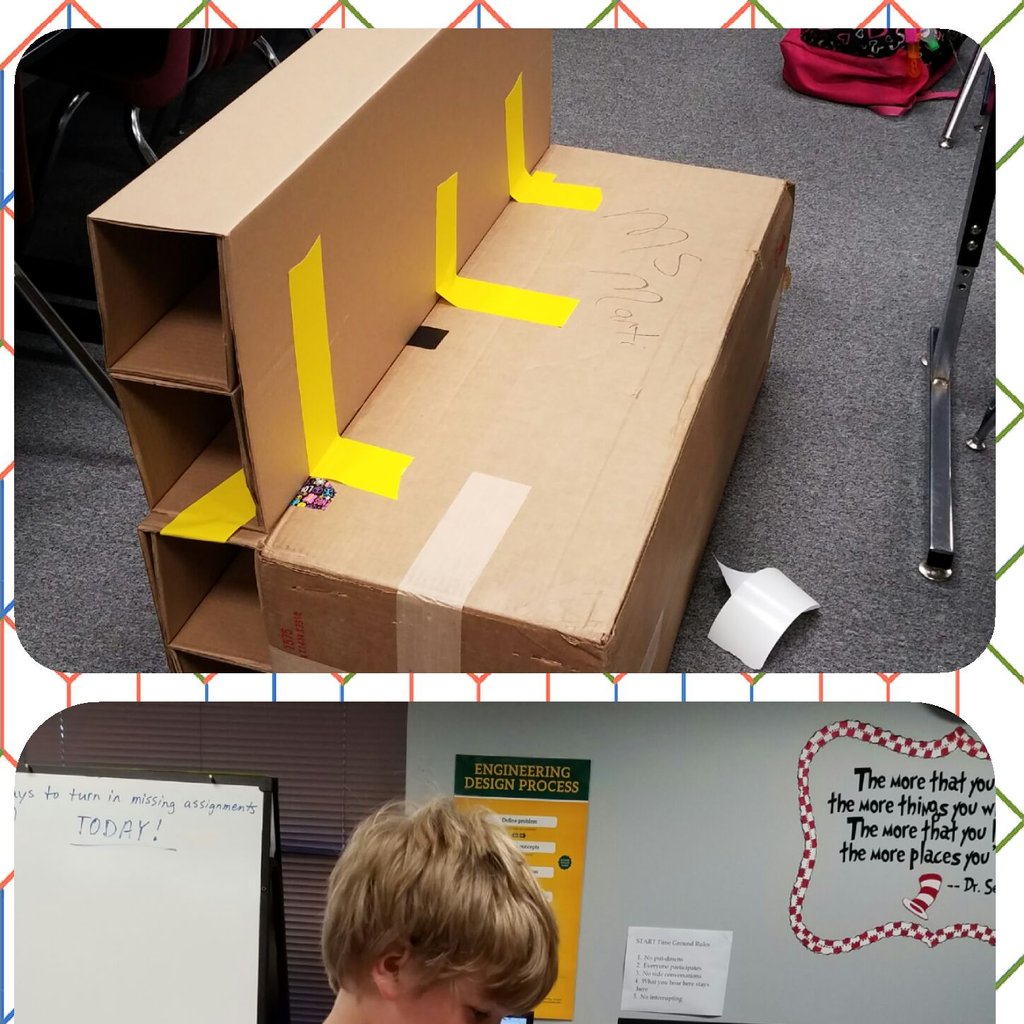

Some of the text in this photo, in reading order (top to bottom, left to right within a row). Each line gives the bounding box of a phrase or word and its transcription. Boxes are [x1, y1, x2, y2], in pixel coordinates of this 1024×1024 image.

[464, 777, 579, 793] DESIGN PROCESS
[474, 763, 571, 779] ENGINEERING
[854, 767, 886, 792] The
[929, 770, 967, 793] that
[968, 775, 995, 798] you
[44, 786, 59, 800] to
[69, 788, 101, 801] turn
[108, 789, 121, 803] in
[131, 793, 176, 814] missing
[183, 799, 258, 816] assignments
[827, 792, 855, 814] the
[951, 801, 978, 822] you
[76, 815, 163, 842] TODAY!
[847, 816, 878, 840] The
[921, 820, 958, 842] that
[960, 826, 986, 847] you
[839, 841, 866, 863] the
[909, 841, 961, 870] places
[963, 877, 981, 893] Dr.
